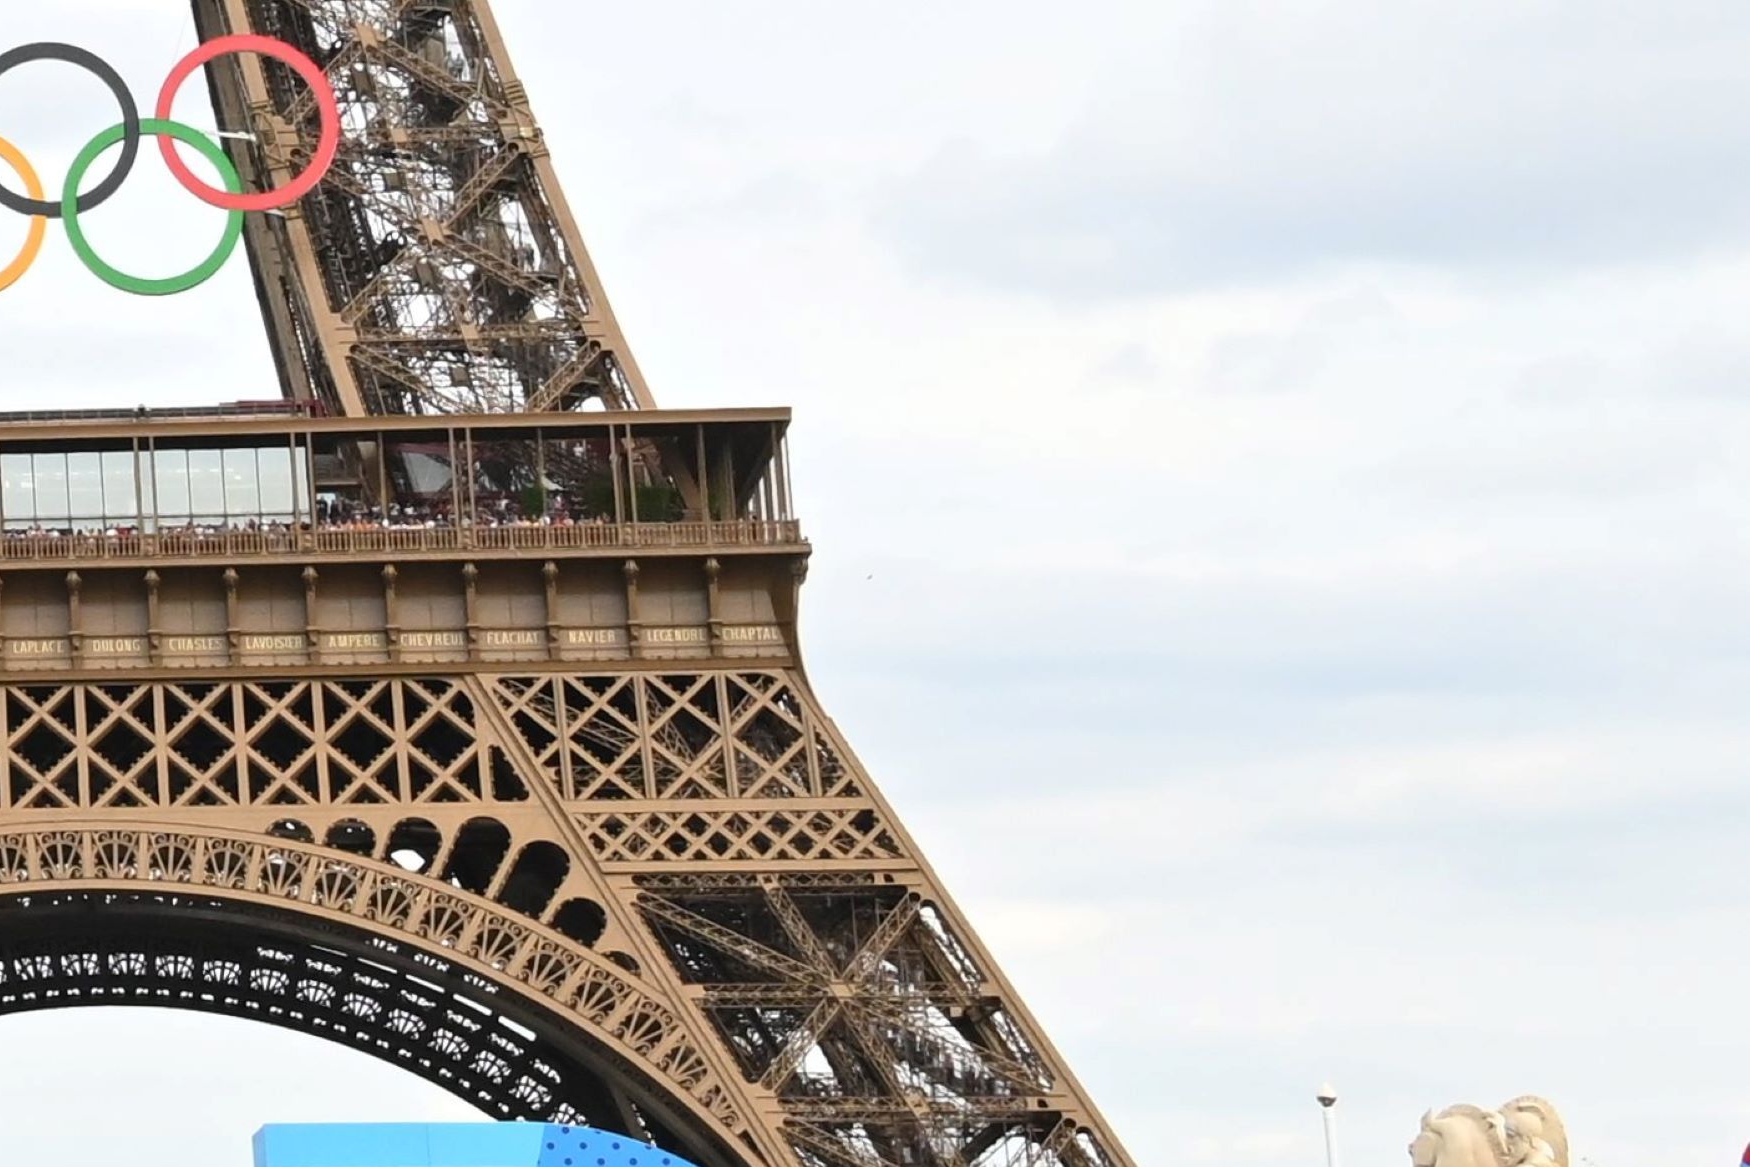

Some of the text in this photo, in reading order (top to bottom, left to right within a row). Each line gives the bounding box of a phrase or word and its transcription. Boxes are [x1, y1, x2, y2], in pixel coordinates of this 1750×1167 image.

[401, 632, 464, 646] CHEVREUL
[487, 631, 538, 645] FLACHAT
[569, 628, 615, 644] NAVIER
[722, 625, 778, 641] CHAPTAL
[13, 640, 64, 654] LAPLACE
[92, 638, 140, 652] DULONG
[168, 637, 222, 651] CHASLES
[246, 635, 302, 649] LAVOISIER
[328, 633, 380, 648] AMPERE
